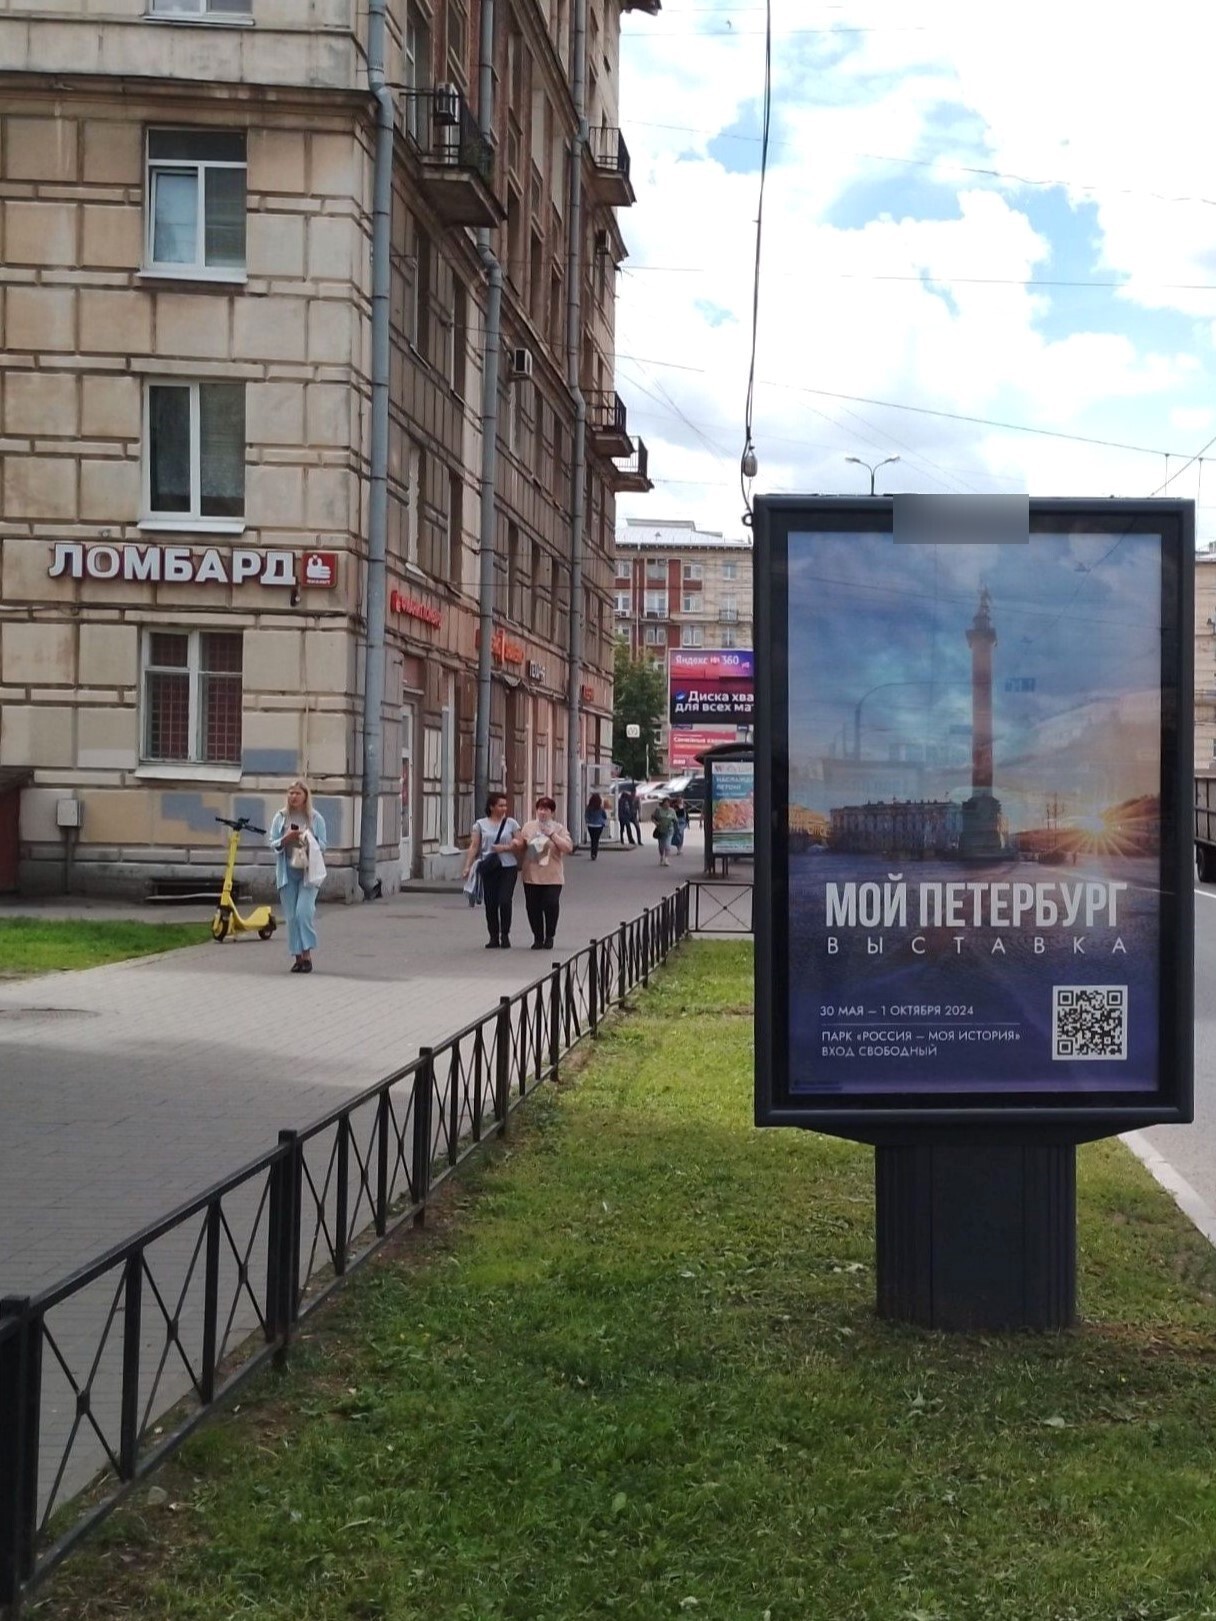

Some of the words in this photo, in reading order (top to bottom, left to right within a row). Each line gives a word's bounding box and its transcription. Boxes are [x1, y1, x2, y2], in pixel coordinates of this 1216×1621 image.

[49, 543, 296, 586] ЛОМБАРД
[676, 655, 707, 667] Яндекс
[721, 655, 740, 665] 360
[688, 690, 730, 703] Диска
[675, 703, 700, 713] для
[702, 703, 732, 712] всех
[734, 703, 754, 712] ма
[825, 872, 907, 927] МОЙ
[918, 882, 1128, 927] ПЕТЕРБУРГ
[827, 936, 1128, 955] ВЫСТАВКА
[819, 1005, 835, 1017] 30
[838, 1005, 865, 1017] МАЯ
[881, 1005, 887, 1016] 1
[890, 1005, 942, 1017] ОКТЯБРЯ
[944, 1005, 975, 1016] 2024
[821, 1031, 853, 1042] ПАРК
[856, 1031, 912, 1042] «РОССИЯ
[928, 1030, 955, 1041] МОЯ
[958, 1030, 1021, 1041] ИСТОРИЯ»
[821, 1046, 855, 1058] ВХОД
[858, 1043, 938, 1057] СВОБОДНЫЙ
